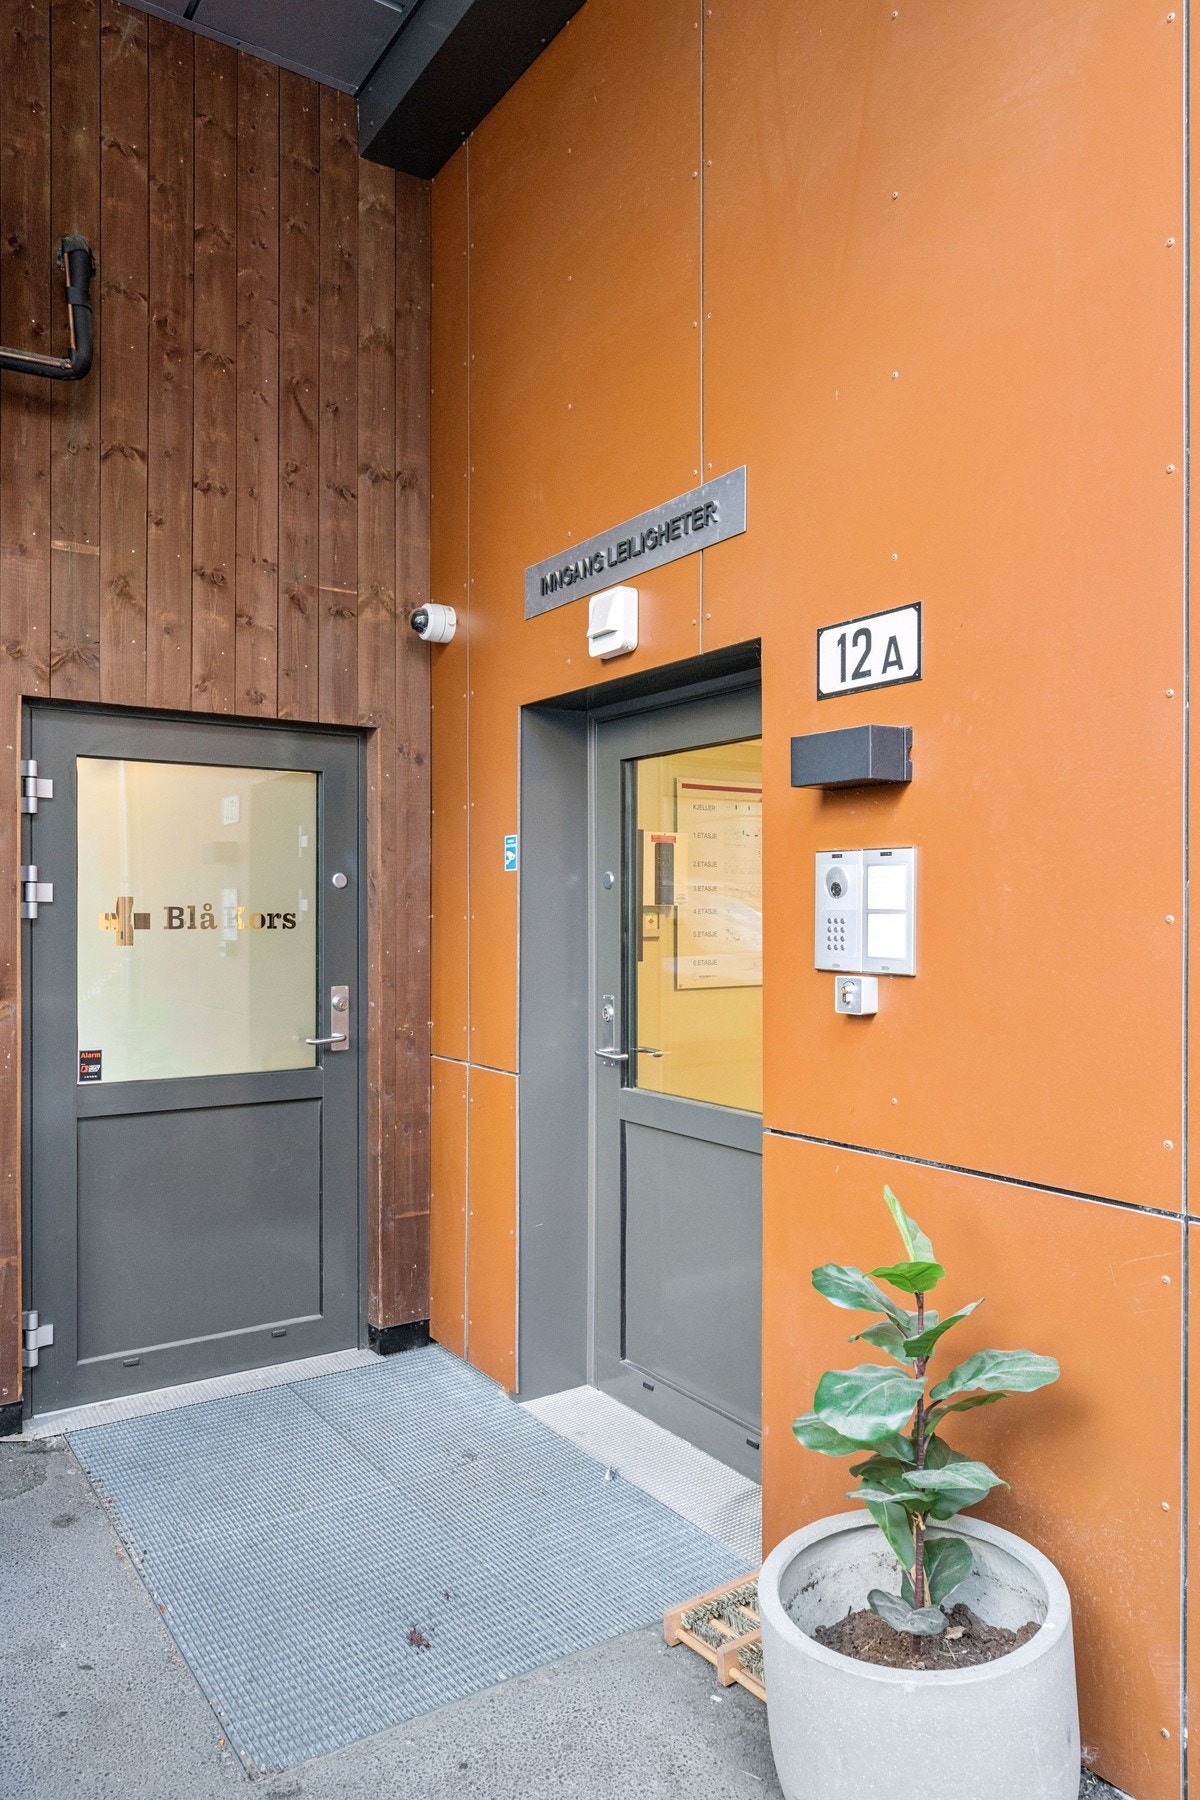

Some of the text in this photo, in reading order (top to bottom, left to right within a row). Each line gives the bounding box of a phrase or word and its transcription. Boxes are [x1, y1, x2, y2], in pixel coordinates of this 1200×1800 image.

[540, 501, 718, 596] INNGANG LEILIGHETER
[837, 627, 904, 683] 12 A
[163, 903, 296, 930] Blå Kors
